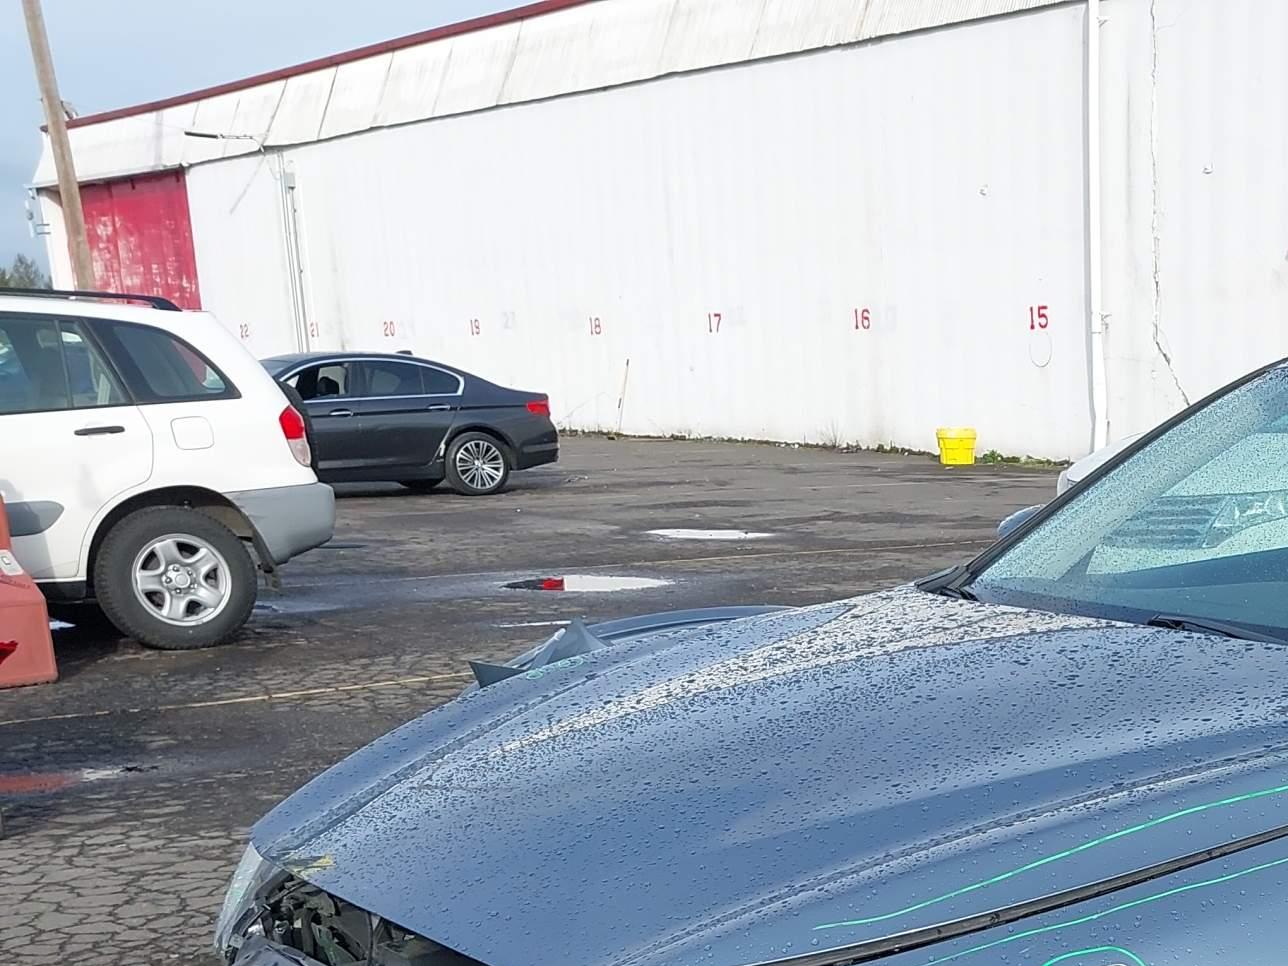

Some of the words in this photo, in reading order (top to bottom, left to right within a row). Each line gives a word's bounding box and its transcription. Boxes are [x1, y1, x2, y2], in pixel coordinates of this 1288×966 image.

[589, 316, 602, 335] 18
[707, 312, 721, 333] 17
[854, 308, 871, 330] 16
[1029, 305, 1049, 330] 15
[239, 323, 250, 339] 22
[310, 321, 320, 338] 21
[383, 320, 396, 337] 20
[470, 318, 481, 336] 19
